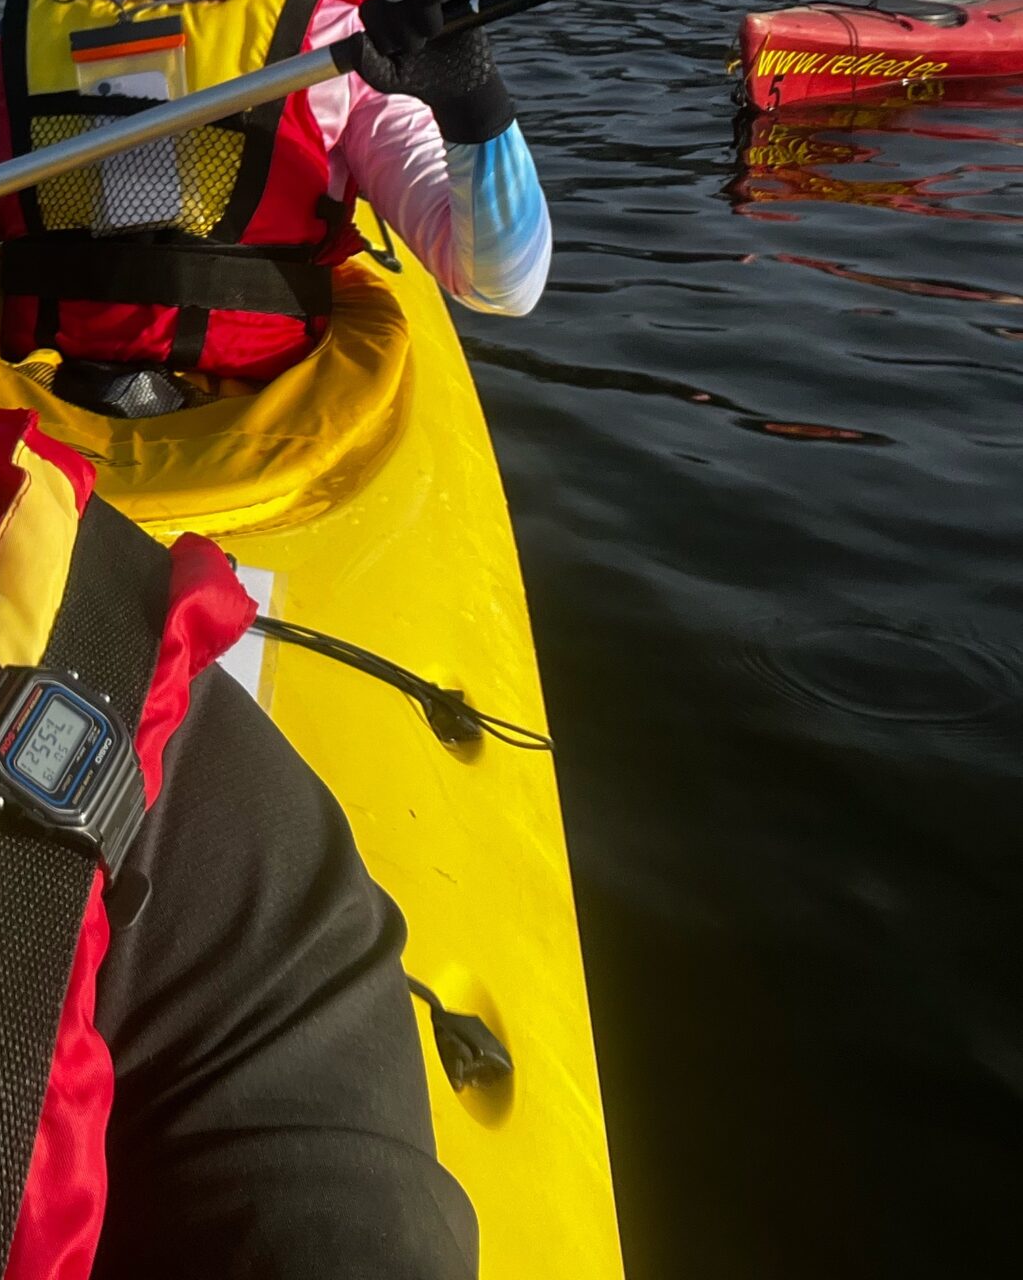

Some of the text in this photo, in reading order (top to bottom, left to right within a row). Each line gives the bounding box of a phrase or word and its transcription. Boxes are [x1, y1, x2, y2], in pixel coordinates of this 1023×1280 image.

[757, 50, 948, 78] www.retked.ee
[769, 75, 785, 109] 5
[95, 738, 112, 764] CASIO
